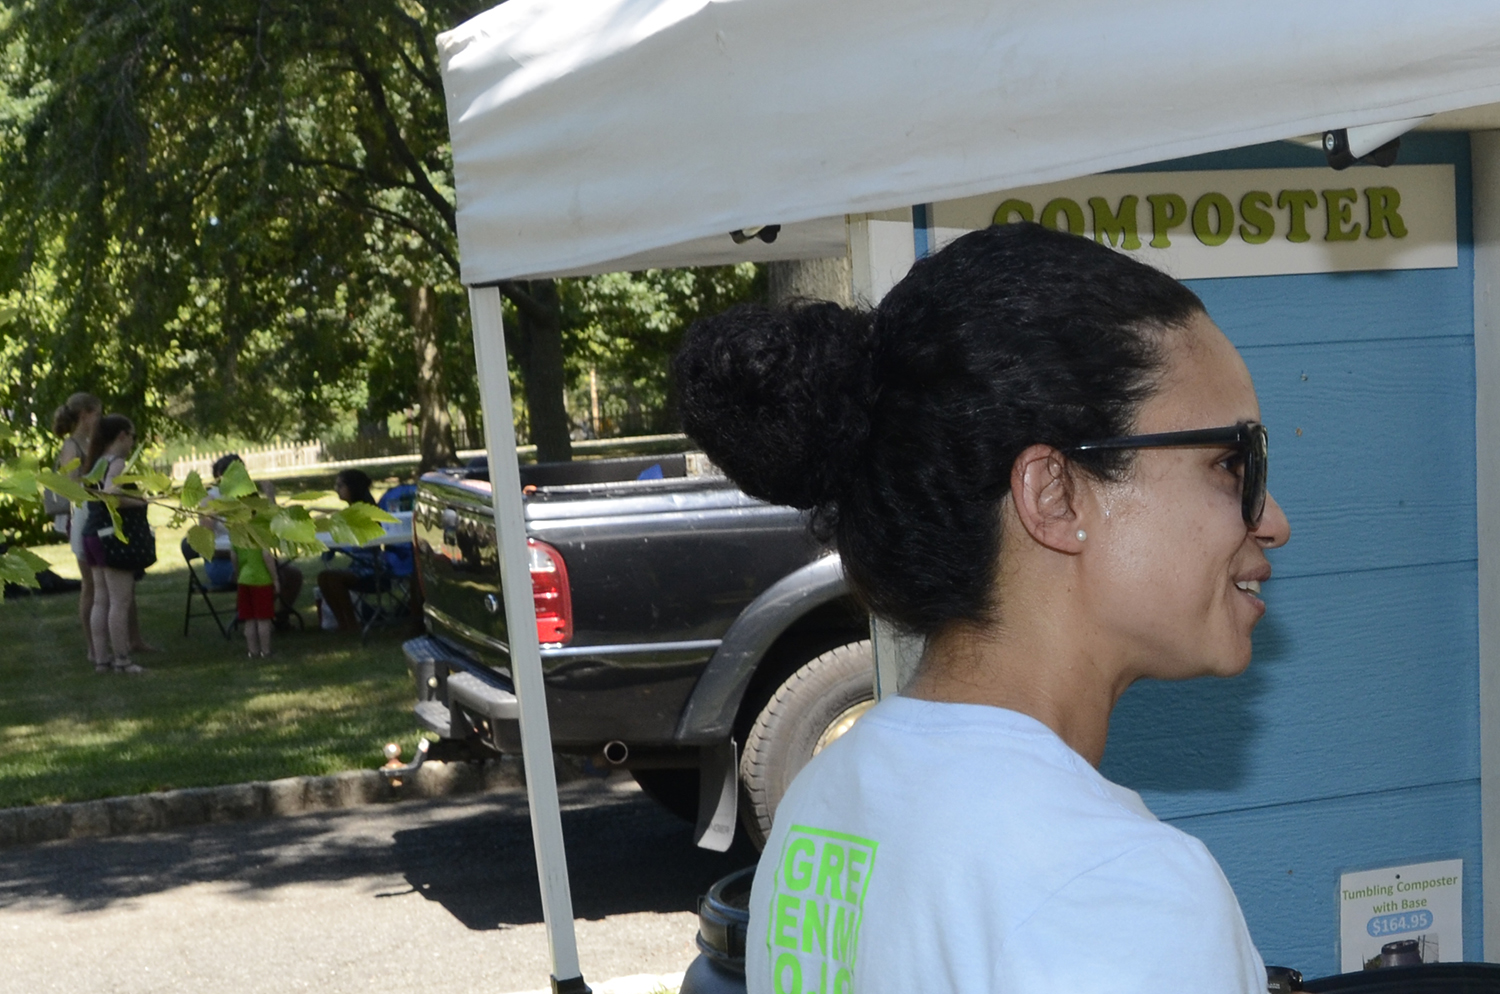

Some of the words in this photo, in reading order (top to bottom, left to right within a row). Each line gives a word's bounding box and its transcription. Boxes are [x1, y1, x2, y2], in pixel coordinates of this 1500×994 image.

[784, 837, 868, 905] GRE
[1342, 885, 1394, 901] Tumbling
[1396, 876, 1458, 893] Composter
[1373, 900, 1398, 914] with
[1401, 898, 1427, 910] Base
[1372, 912, 1428, 935] $164.95
